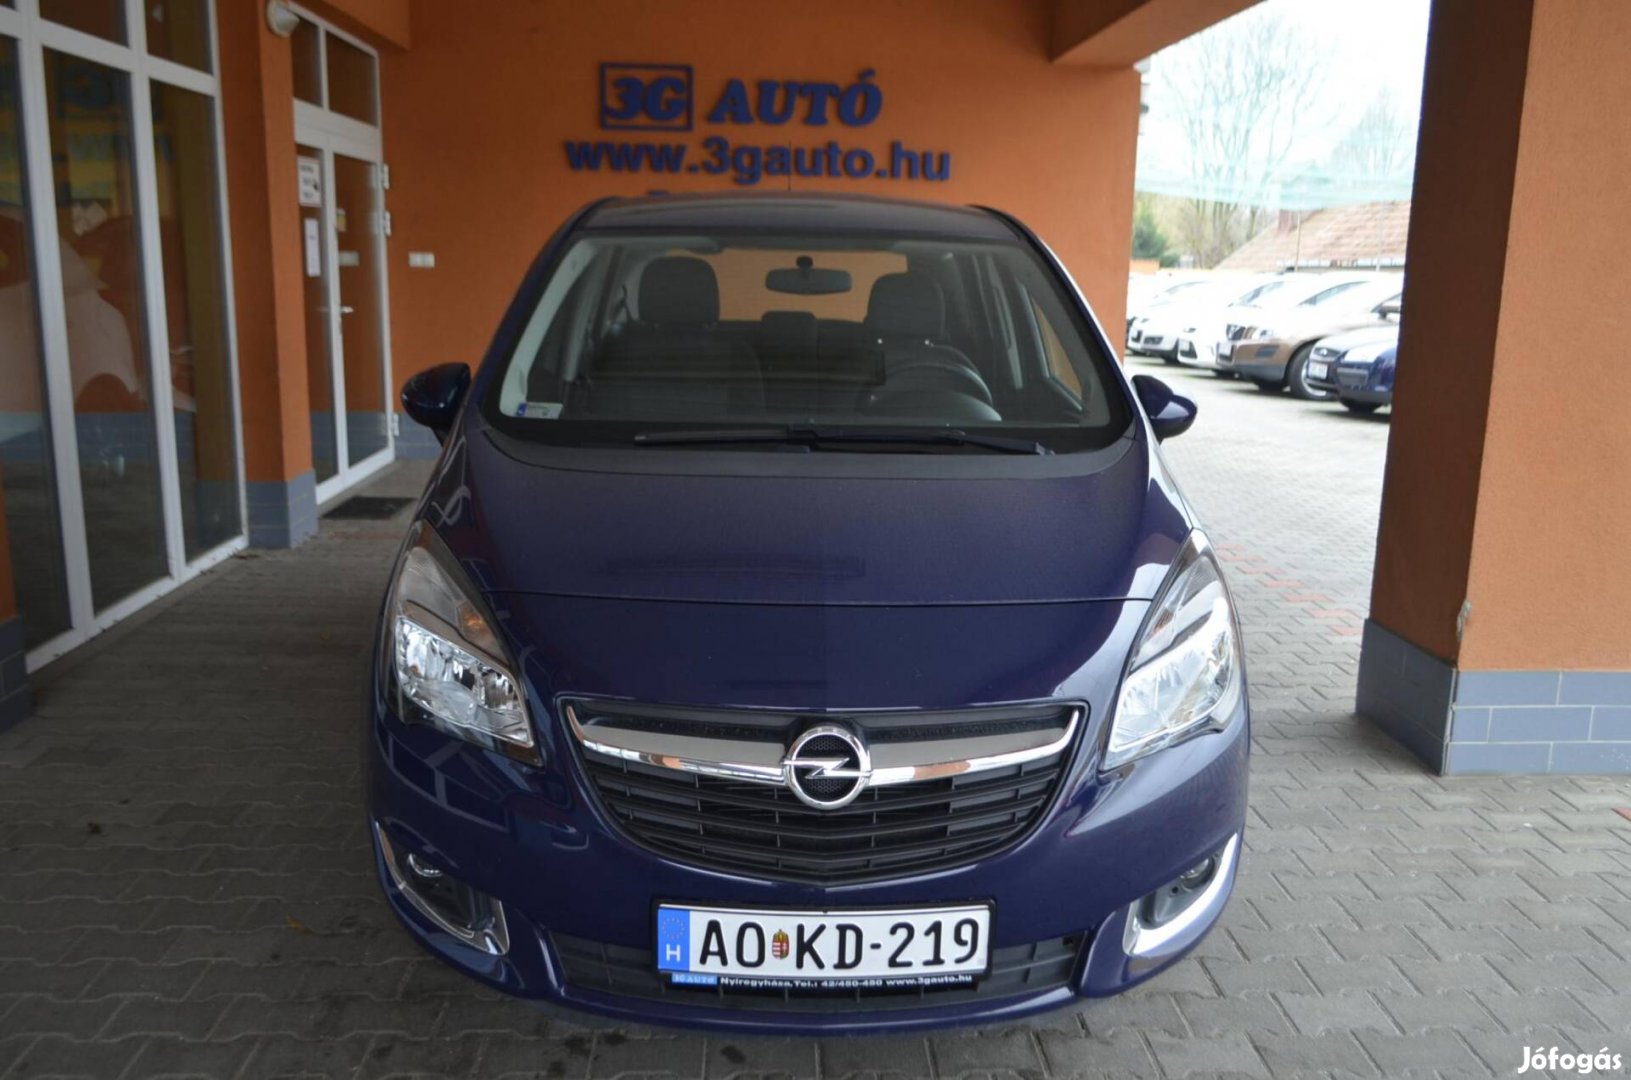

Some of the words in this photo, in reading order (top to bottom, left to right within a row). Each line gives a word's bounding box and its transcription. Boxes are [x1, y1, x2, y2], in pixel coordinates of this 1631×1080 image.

[604, 76, 687, 121] 3G
[707, 69, 883, 126] AUTÓ
[564, 136, 951, 185] www.3gauto.hu
[666, 944, 681, 962] H
[699, 919, 766, 968] AO
[795, 917, 980, 970] KD-219
[886, 975, 972, 987] www.3gauto.hu
